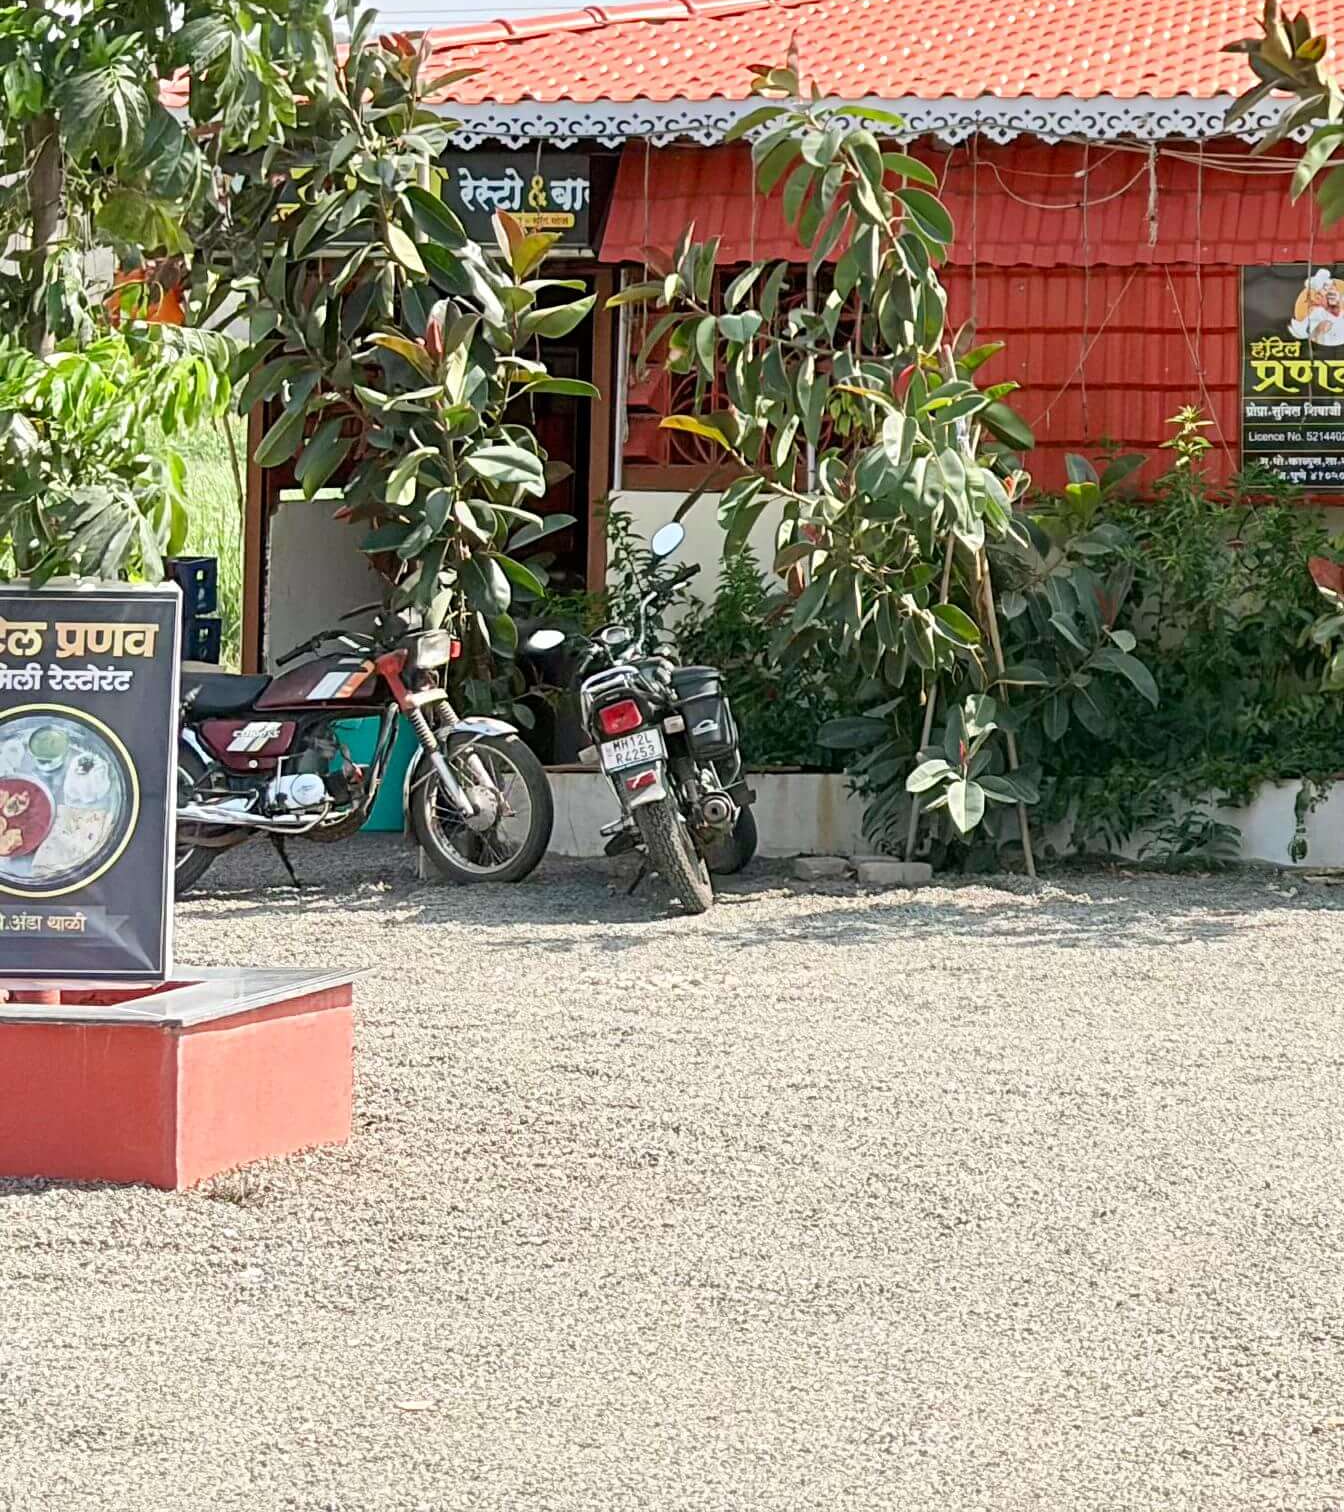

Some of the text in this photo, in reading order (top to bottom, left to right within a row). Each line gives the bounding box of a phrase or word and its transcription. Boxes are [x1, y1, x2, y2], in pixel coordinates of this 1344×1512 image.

[457, 167, 525, 212] रेस्टो
[528, 175, 547, 208] &
[1250, 336, 1301, 360] हॉटेल
[1248, 431, 1286, 442] Licence
[55, 621, 160, 658] प्रणव
[48, 662, 134, 692] रेस्टोरंट
[615, 744, 656, 765] R4253
[47, 911, 89, 933] थाळी
